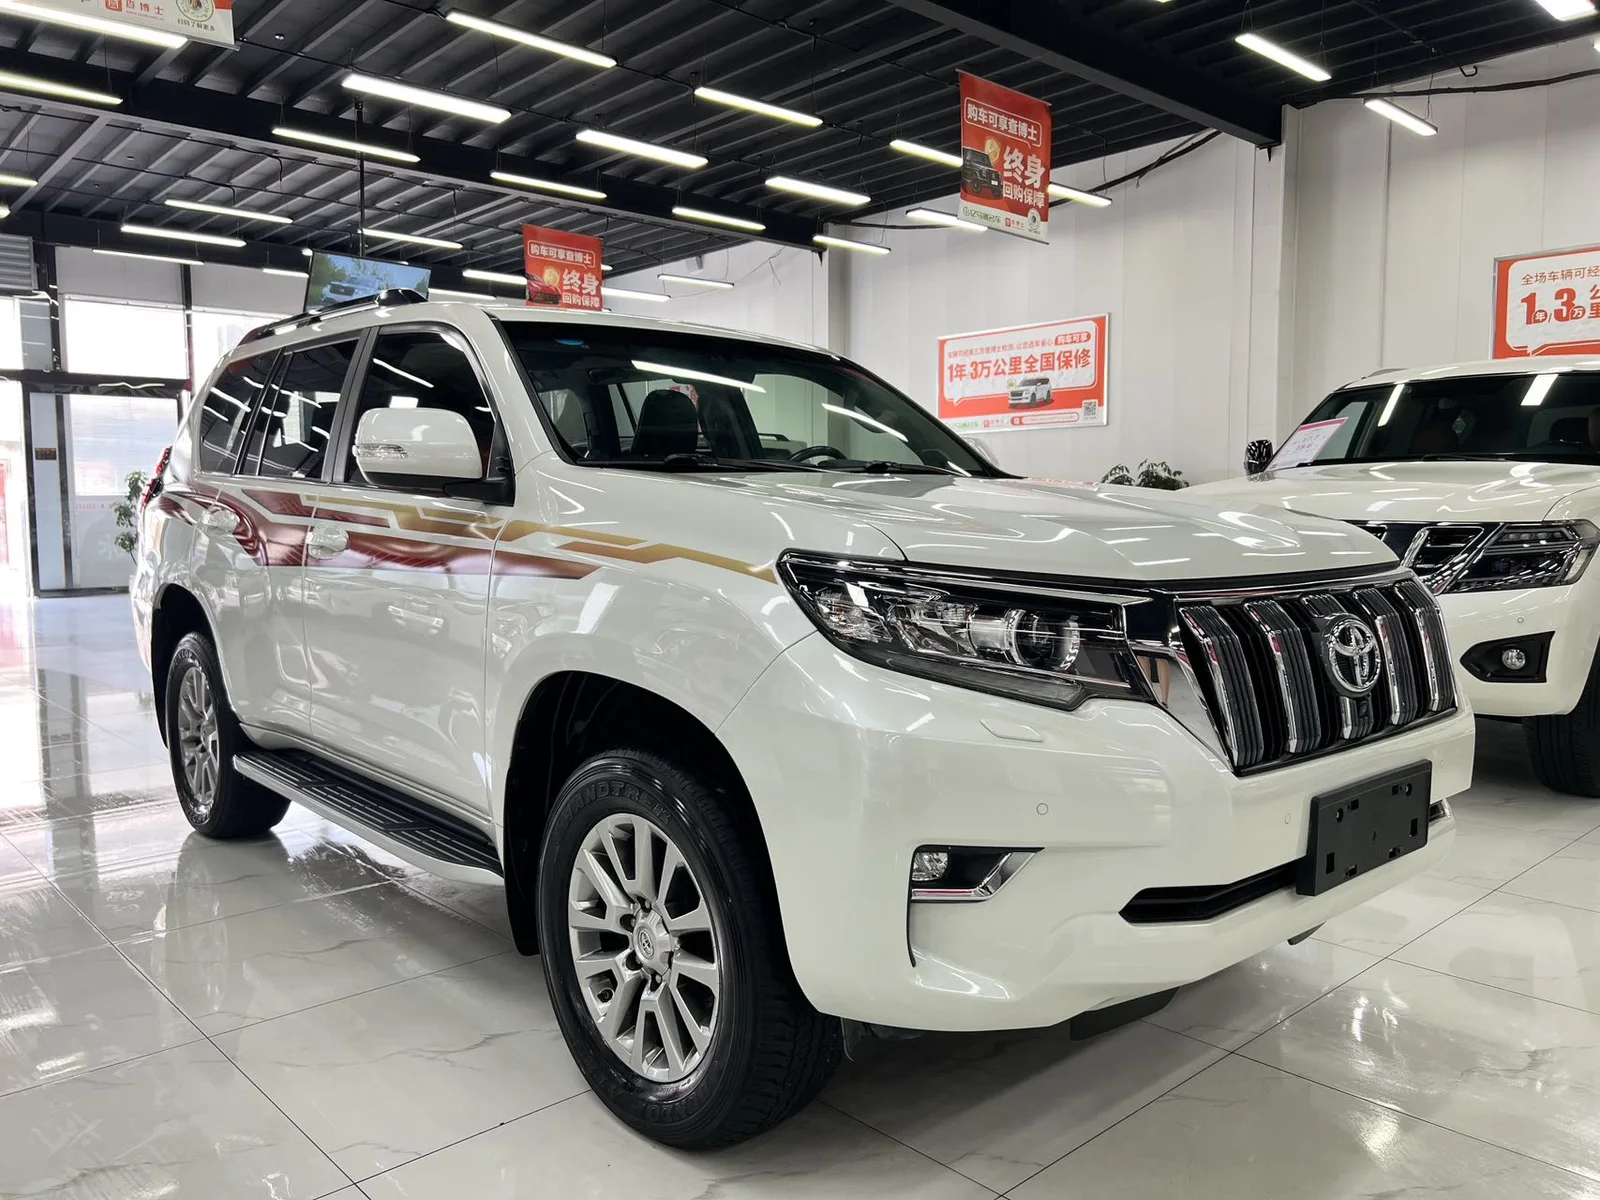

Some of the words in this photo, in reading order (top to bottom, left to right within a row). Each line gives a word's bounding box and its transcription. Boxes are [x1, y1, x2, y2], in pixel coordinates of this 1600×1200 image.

[967, 103, 1037, 140] 购车可享查博士
[1003, 145, 1046, 189] 终身
[1002, 180, 1046, 209] 回购保障
[531, 244, 592, 264] 购车可享查博士
[562, 268, 600, 296] 终身
[1522, 266, 1600, 285] 全场车辆可经
[562, 293, 600, 308] 回购保障
